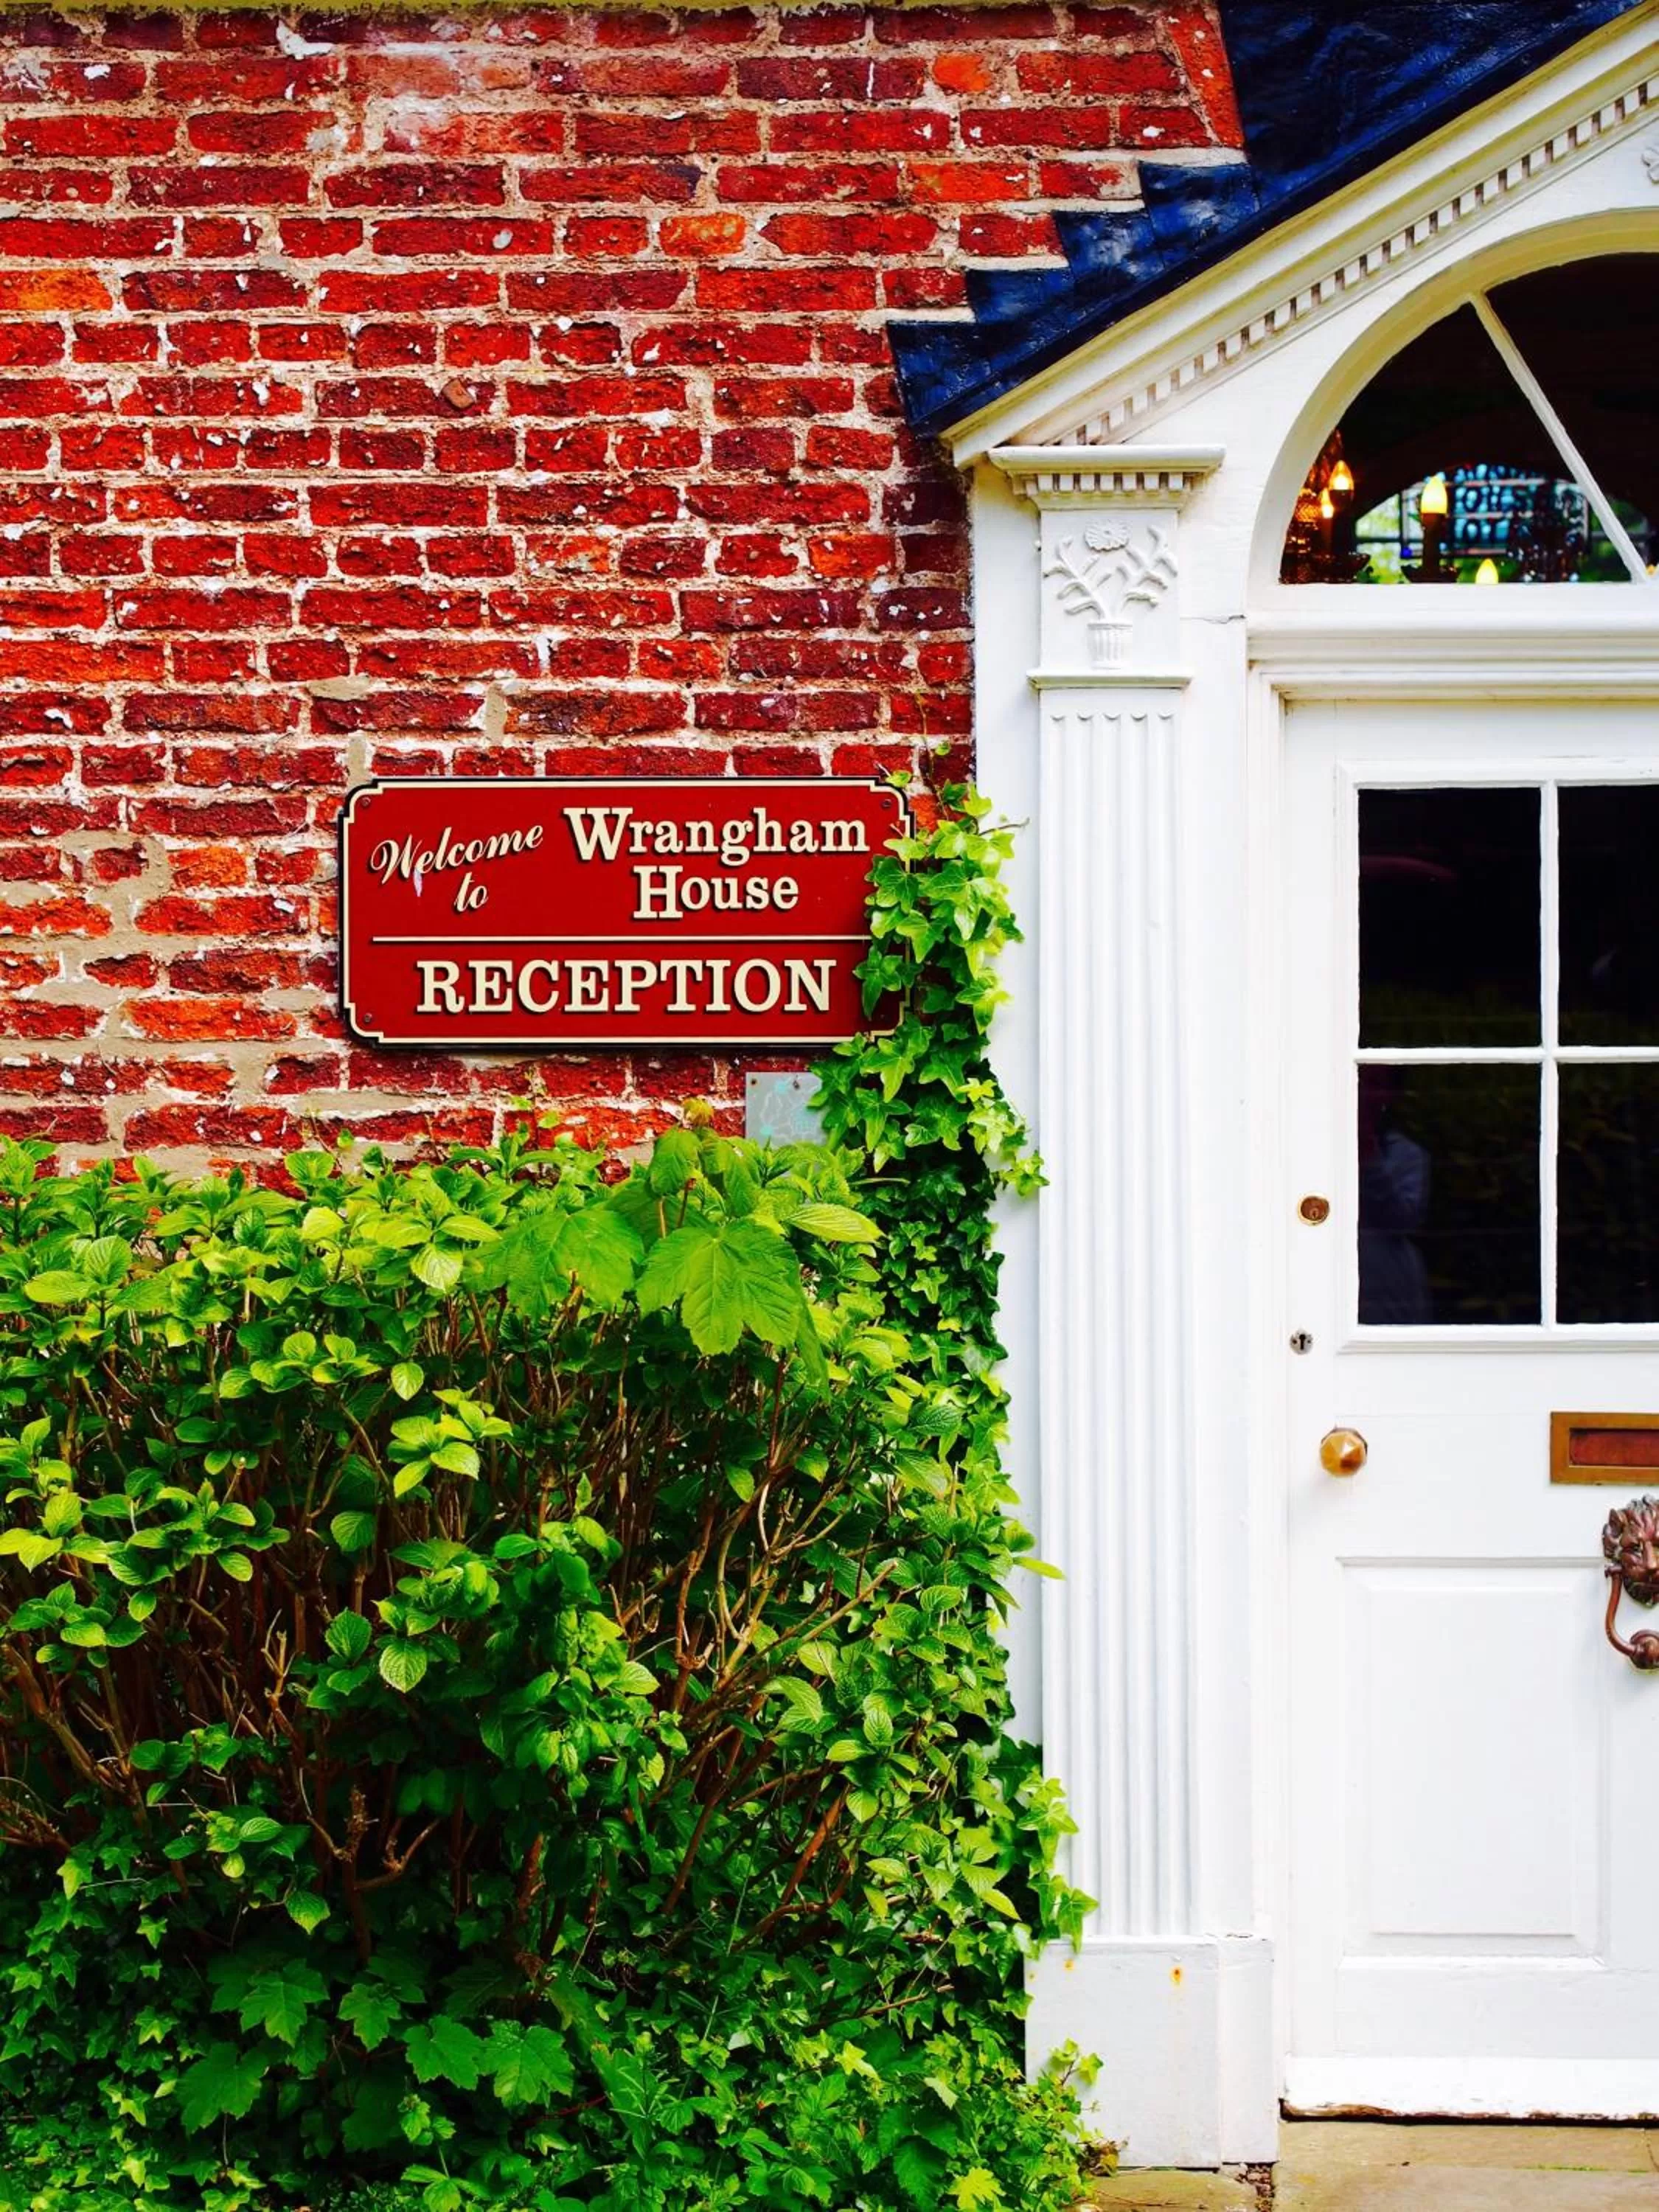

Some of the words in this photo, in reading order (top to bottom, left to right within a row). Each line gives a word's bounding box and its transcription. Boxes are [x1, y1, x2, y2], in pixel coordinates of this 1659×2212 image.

[370, 825, 543, 885] Welcome
[563, 807, 870, 866] Wrangham
[454, 872, 488, 912] to
[633, 865, 799, 919] House
[417, 959, 837, 1013] RECEPTION
